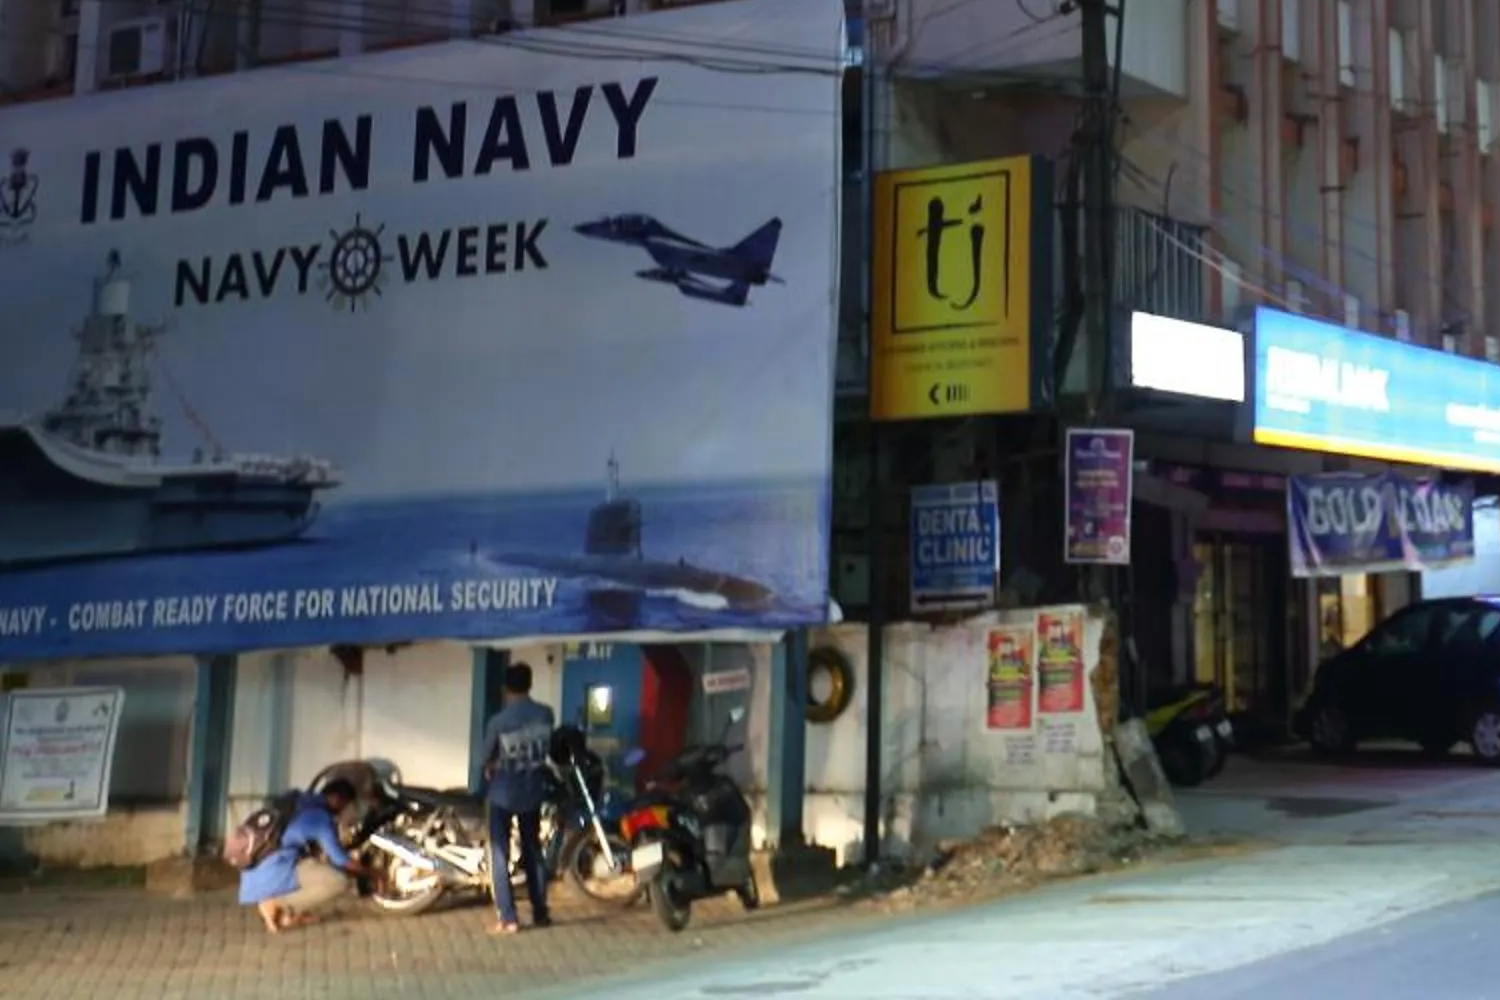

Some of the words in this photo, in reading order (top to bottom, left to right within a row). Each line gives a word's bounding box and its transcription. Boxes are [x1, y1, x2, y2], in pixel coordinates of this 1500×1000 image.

[81, 113, 372, 225] INDIAN
[412, 76, 659, 183] NAVY
[174, 244, 321, 307] NAVY
[397, 217, 549, 283] WEEK
[1308, 485, 1383, 535] GOLD
[1399, 487, 1465, 534] LOAN
[918, 534, 990, 565] CLINIC
[68, 599, 148, 633] COMBAT
[152, 594, 218, 629] READY
[222, 590, 288, 623] FORCE
[294, 587, 334, 620] FOR
[341, 581, 444, 617] NATIONAL
[451, 577, 557, 611] SECURITY
